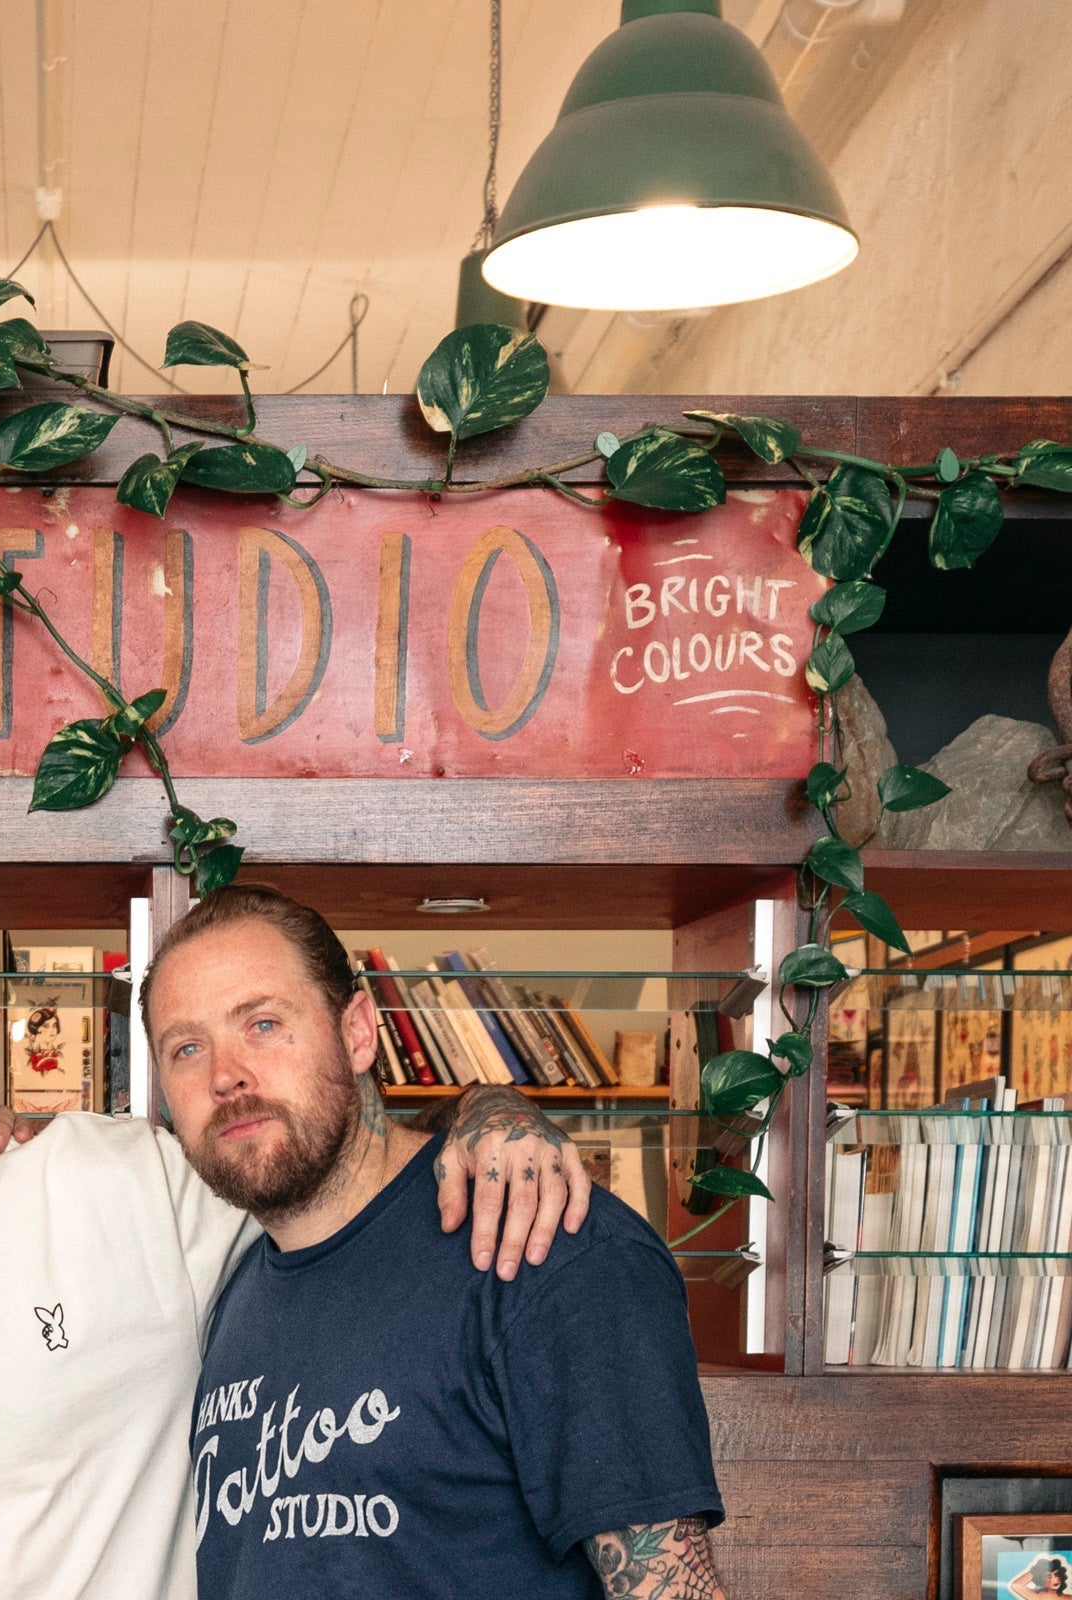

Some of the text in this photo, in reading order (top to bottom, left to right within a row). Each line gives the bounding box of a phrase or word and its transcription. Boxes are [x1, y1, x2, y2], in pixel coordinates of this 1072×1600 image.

[624, 574, 799, 630] BRIGHT
[609, 630, 798, 695] COLOURS
[193, 1383, 401, 1550] Tattoo
[263, 1493, 400, 1544] STUDIO
